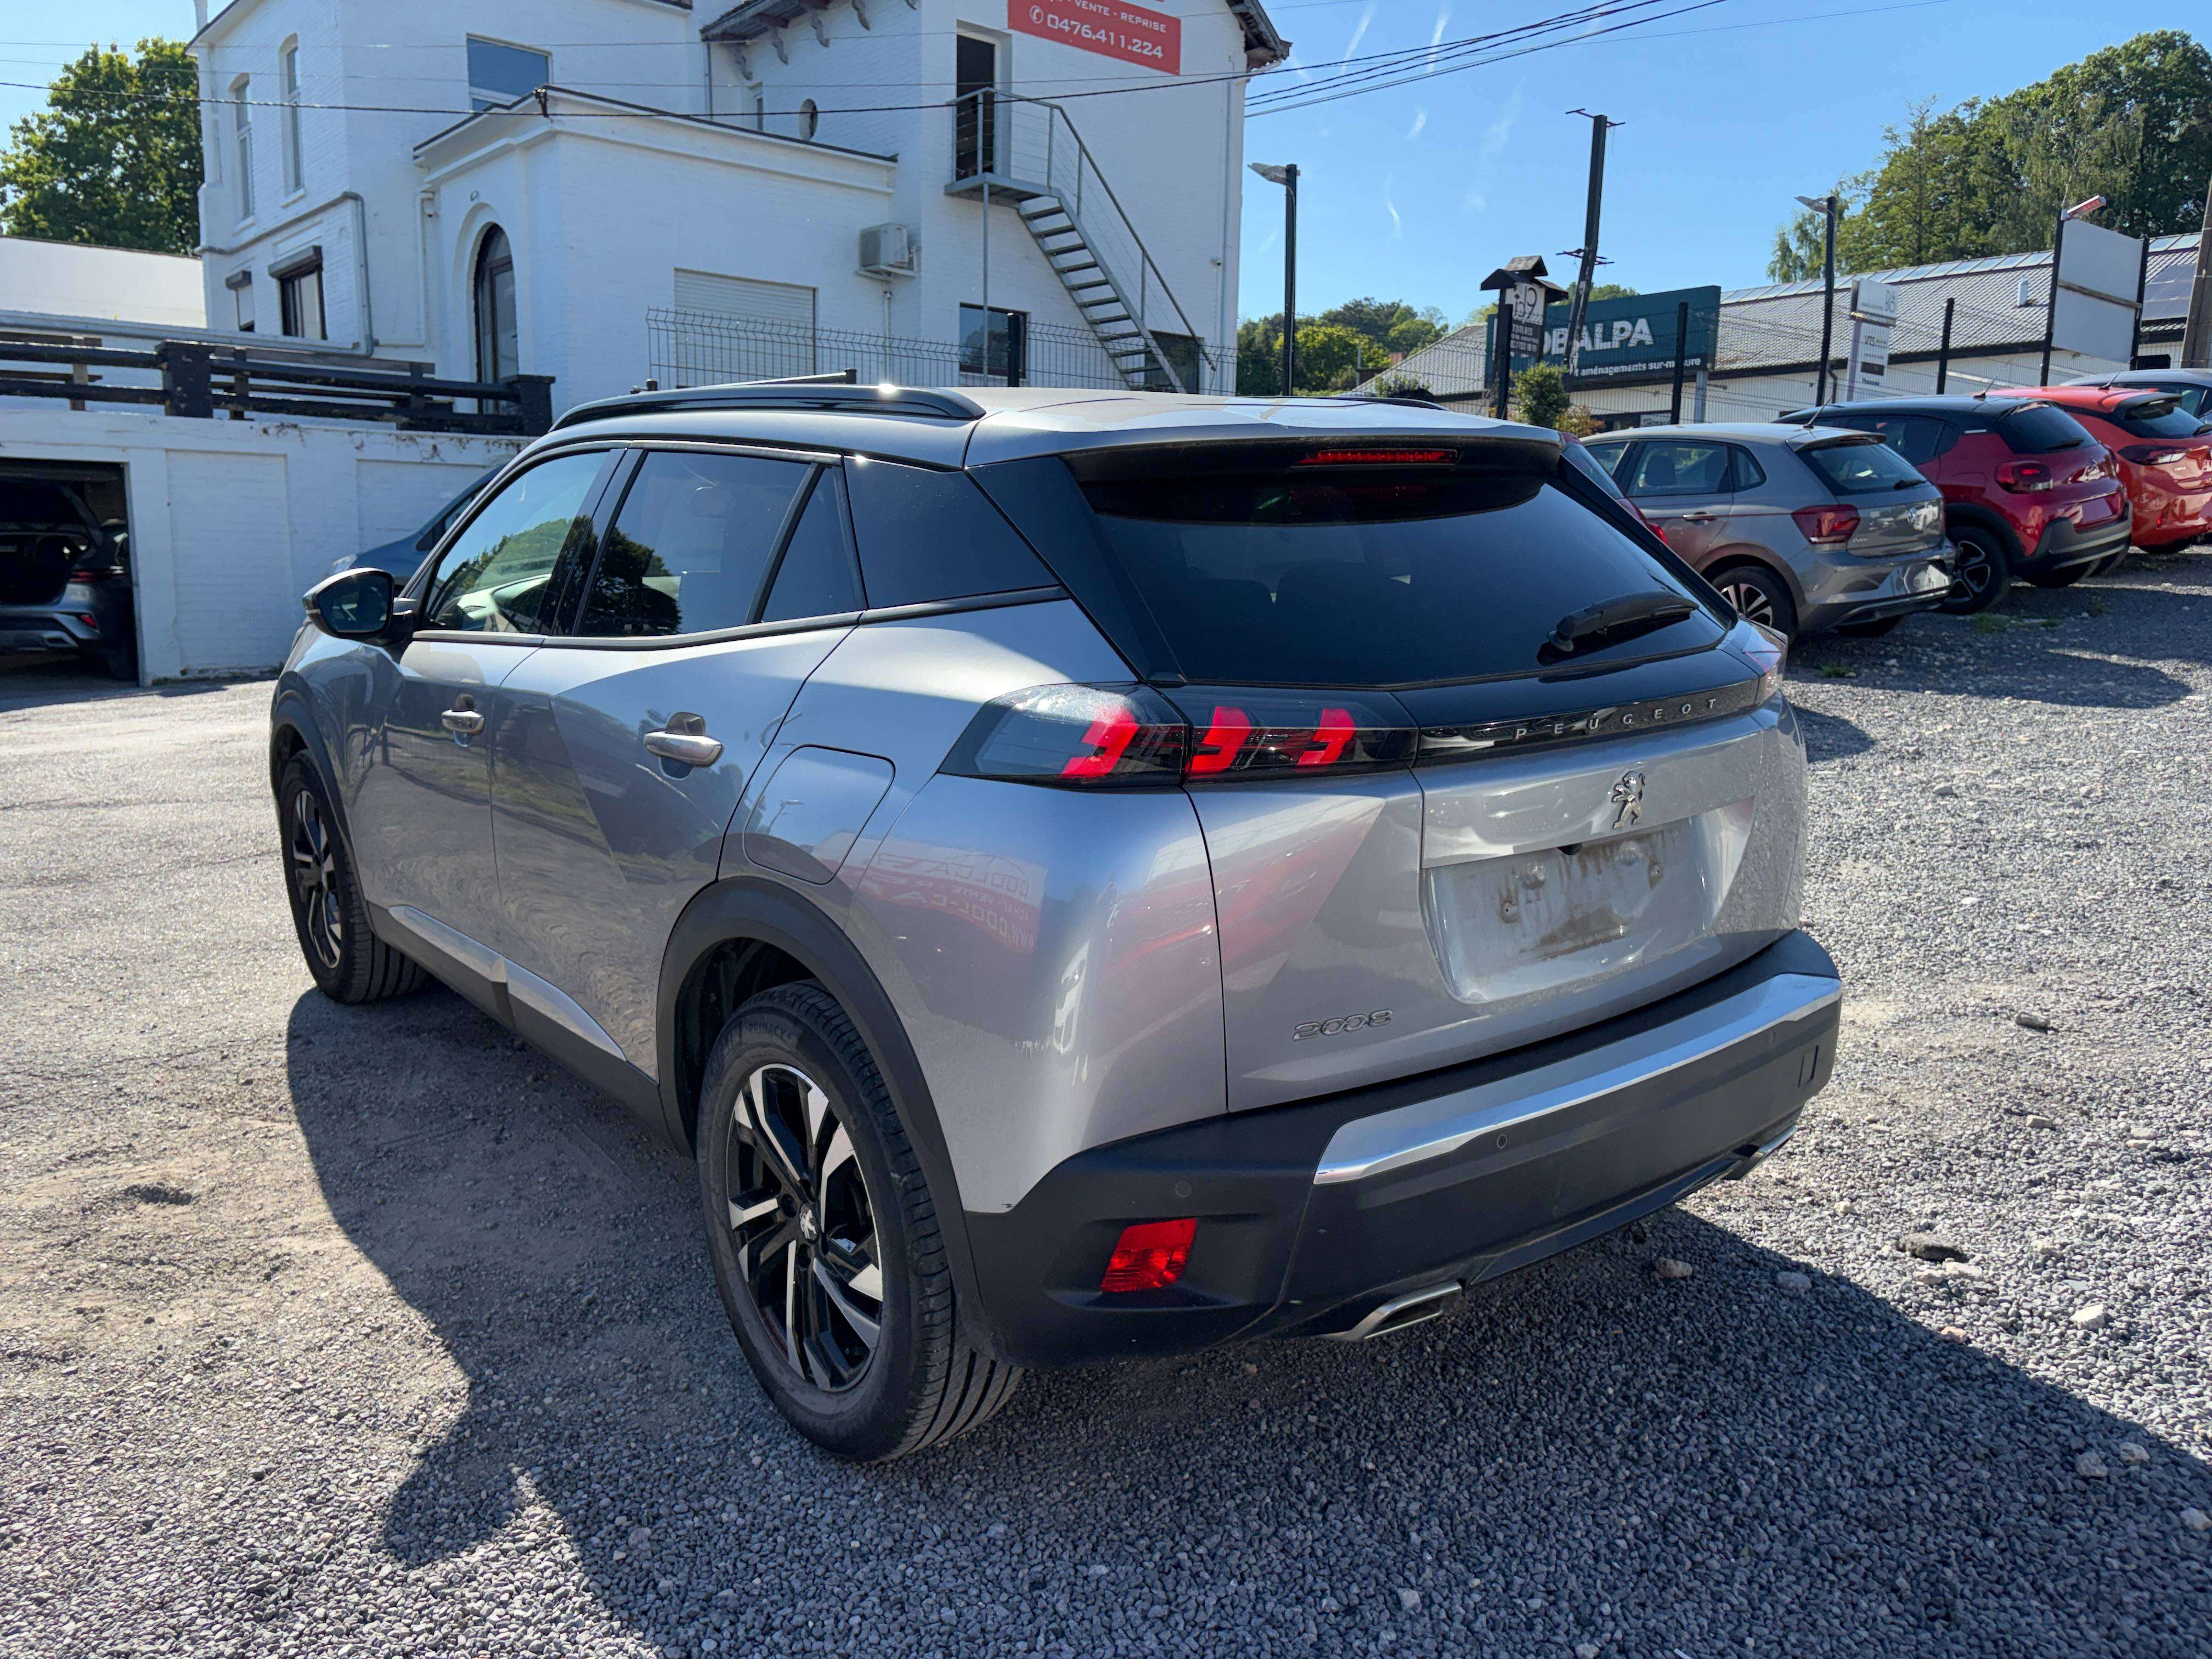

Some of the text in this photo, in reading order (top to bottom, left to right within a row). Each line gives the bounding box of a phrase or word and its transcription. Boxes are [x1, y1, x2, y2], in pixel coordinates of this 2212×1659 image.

[1074, 0, 1110, 16] VENTE
[1120, 12, 1167, 33] REPRISE
[1047, 13, 1163, 59] 0476.411.224
[1581, 361, 1647, 376] aménagements
[1515, 698, 1717, 740] PEUGEOT
[1293, 1008, 1393, 1041] 2008
